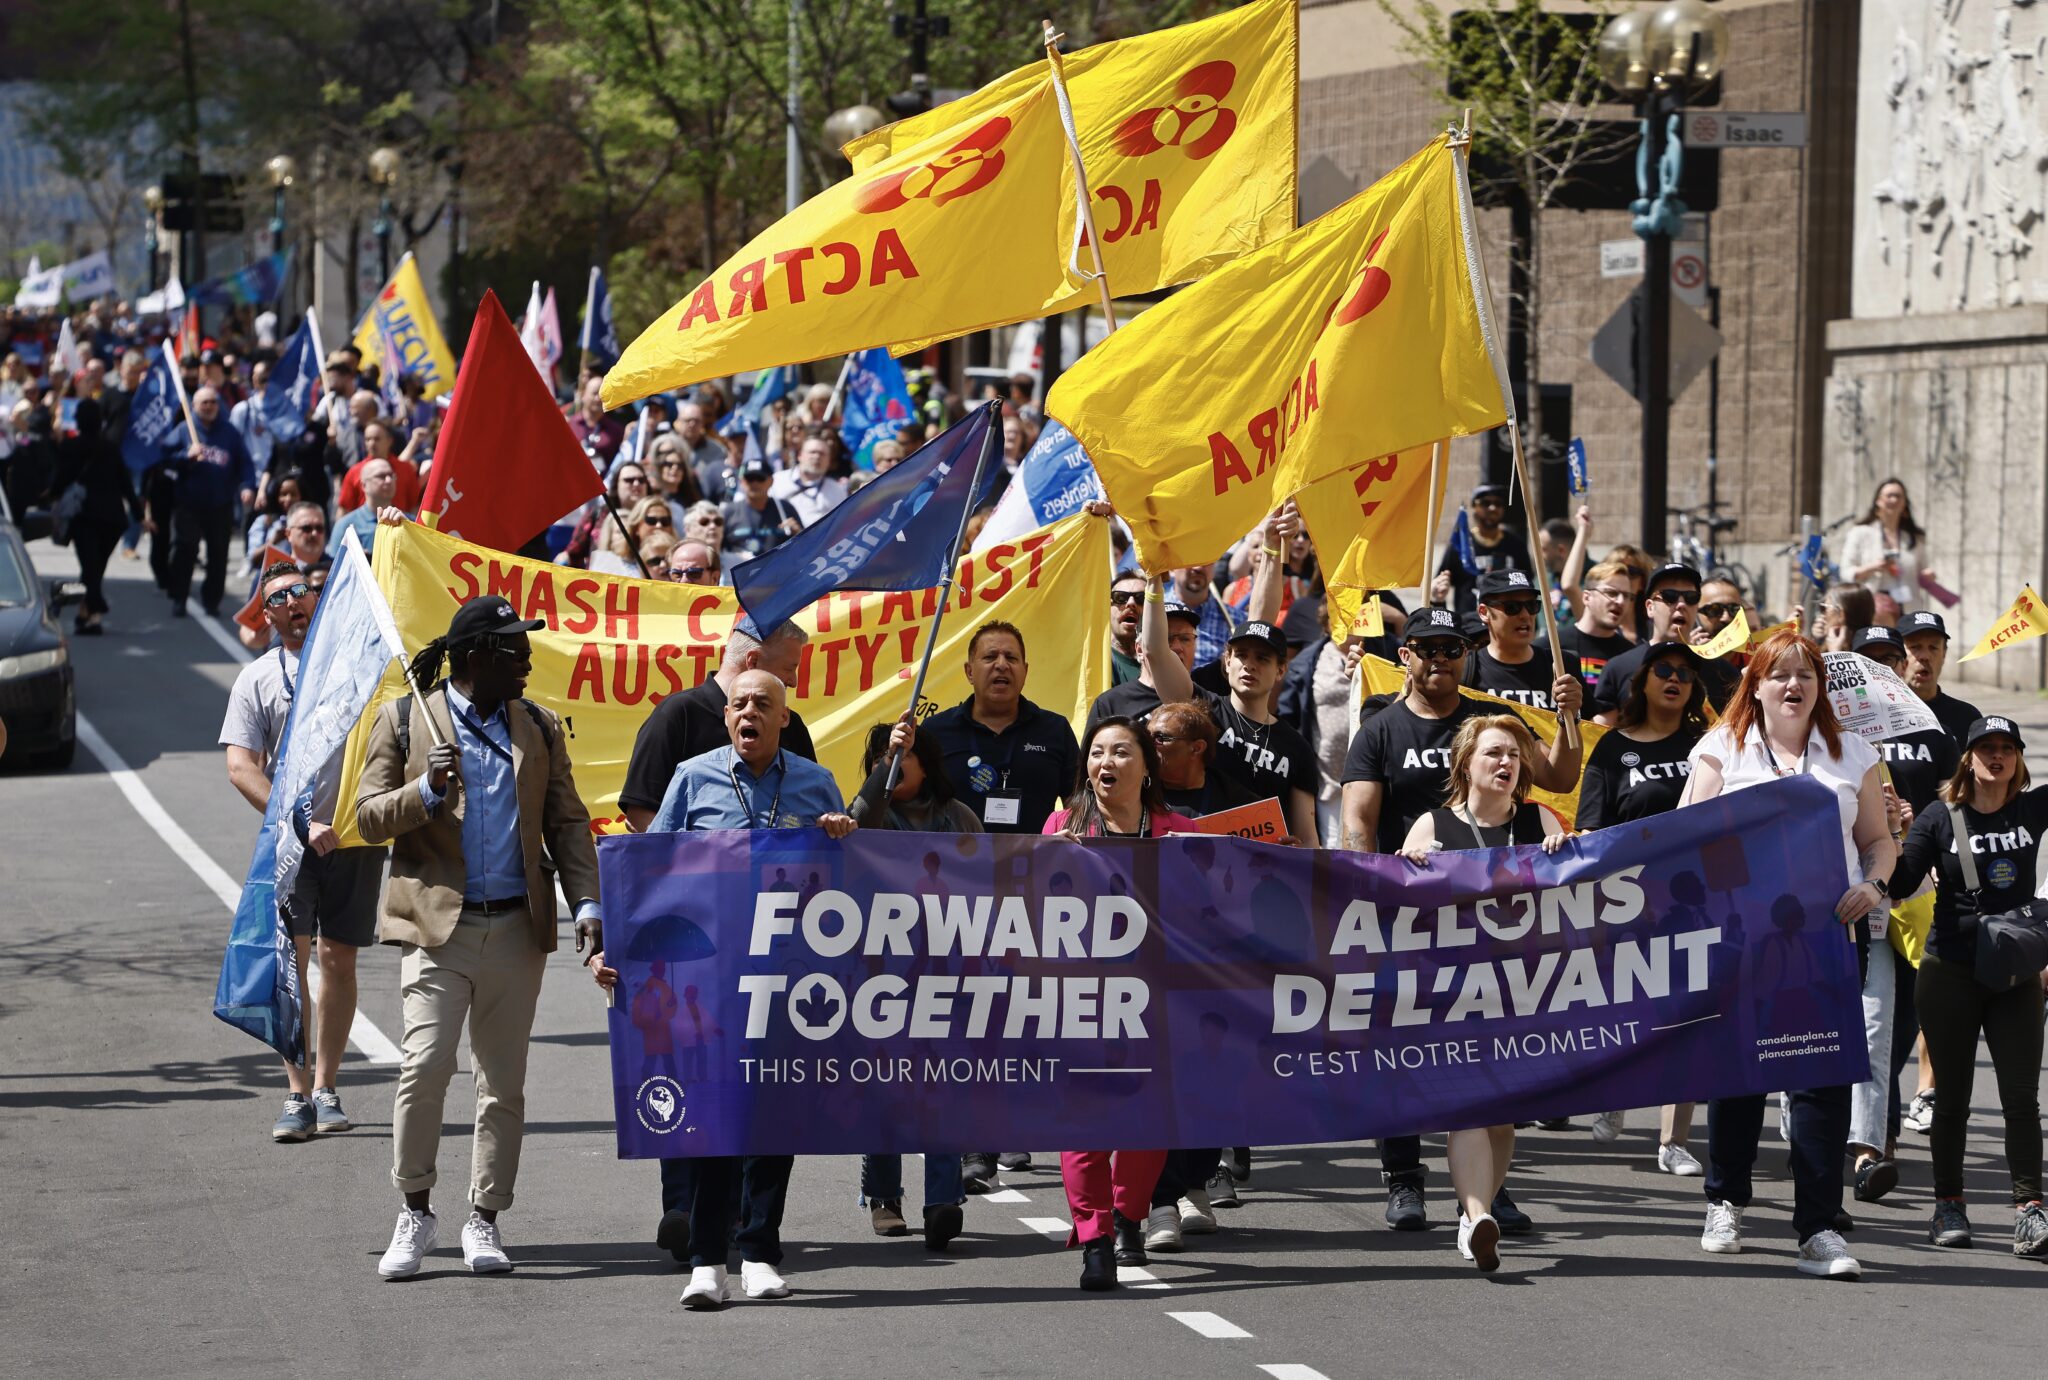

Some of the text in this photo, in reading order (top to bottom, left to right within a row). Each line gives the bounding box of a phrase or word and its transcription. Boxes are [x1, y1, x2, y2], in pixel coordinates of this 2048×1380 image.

[1725, 124, 1784, 142] Isaac
[447, 551, 641, 640] SMASH
[687, 532, 1055, 642] CITALIST
[1697, 636, 1734, 657] ACTRA
[1990, 619, 2030, 649] ACTRA
[567, 626, 920, 706] AUSTITY!
[1827, 675, 1868, 693] ANDS
[1486, 688, 1558, 709] ACTR
[1861, 724, 1884, 735] ACTRA
[1217, 726, 1290, 778] ATRA
[1402, 748, 1453, 769] ACT
[1882, 742, 1933, 762] TRA
[1629, 760, 1692, 788] ACTR
[1329, 864, 1646, 955] ALLONS
[749, 889, 1148, 958] FORWARD
[1272, 927, 1722, 1034] DE L'AVANT
[737, 972, 1150, 1041] TOGETHER
[1273, 1020, 1641, 1078] C'EST NOTRE MOMENT
[1756, 1031, 1839, 1046] canadianplan.ca
[1758, 1044, 1840, 1062] plancanadien.ca
[739, 1058, 1061, 1082] THIS IS OUR MOMENT
